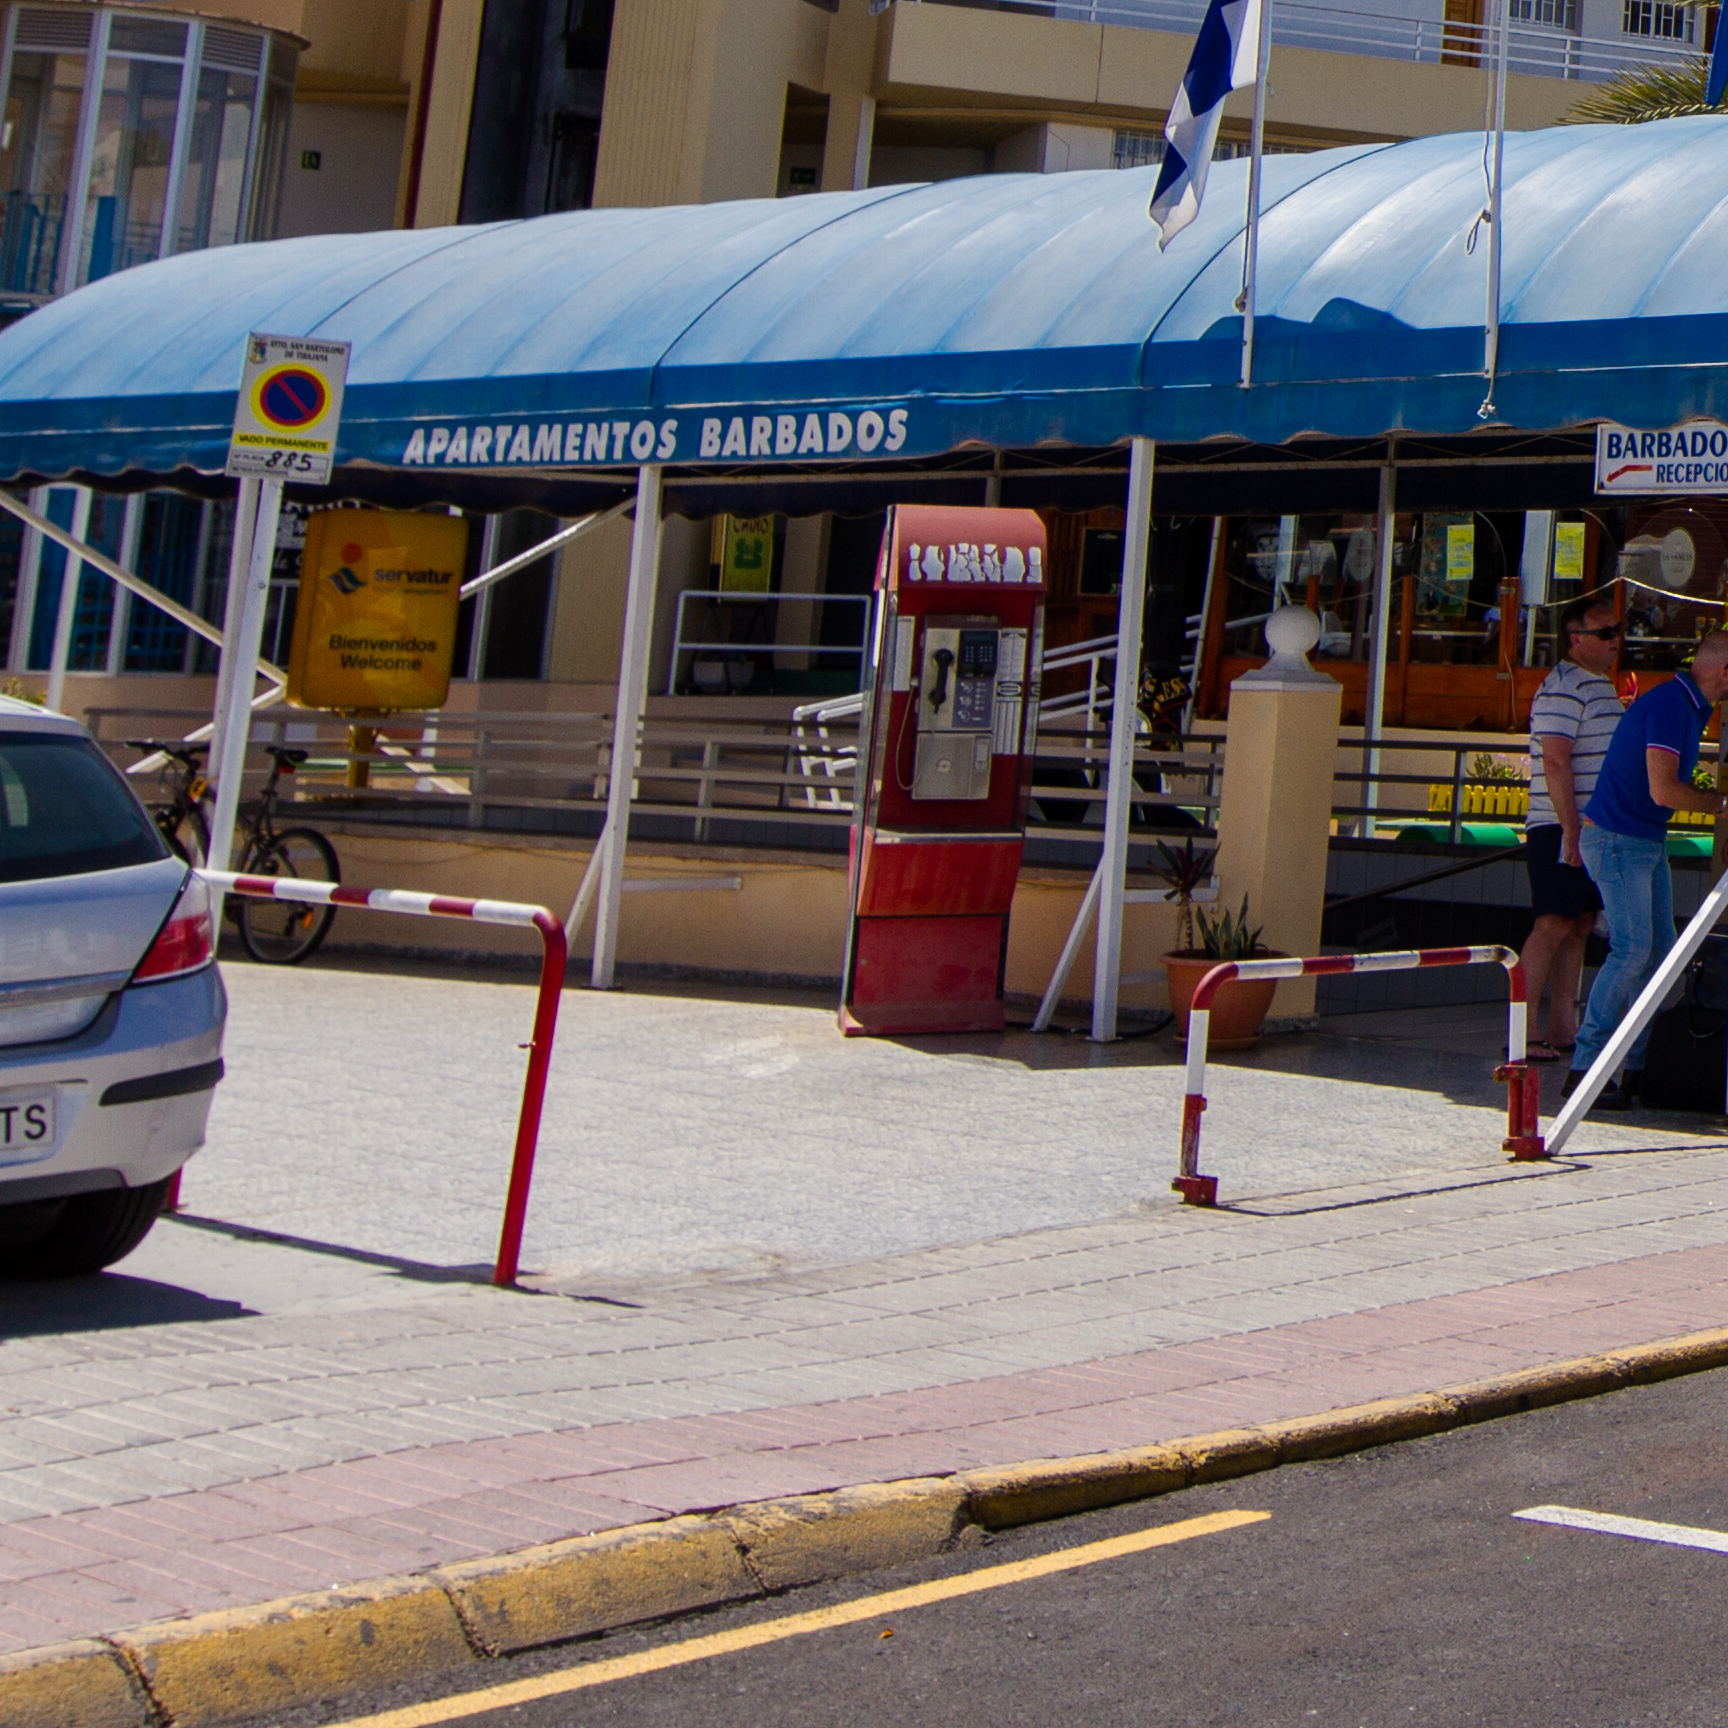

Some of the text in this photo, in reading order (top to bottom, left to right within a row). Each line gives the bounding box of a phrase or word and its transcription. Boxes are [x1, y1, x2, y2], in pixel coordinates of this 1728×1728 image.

[239, 433, 329, 449] VADO PERMANENTE
[403, 409, 909, 465] APARTAMENTOS BARBADOS
[265, 450, 312, 472] 885
[374, 568, 453, 585] servatur
[329, 634, 438, 654] Bienvenidos
[340, 653, 422, 671] Welcome
